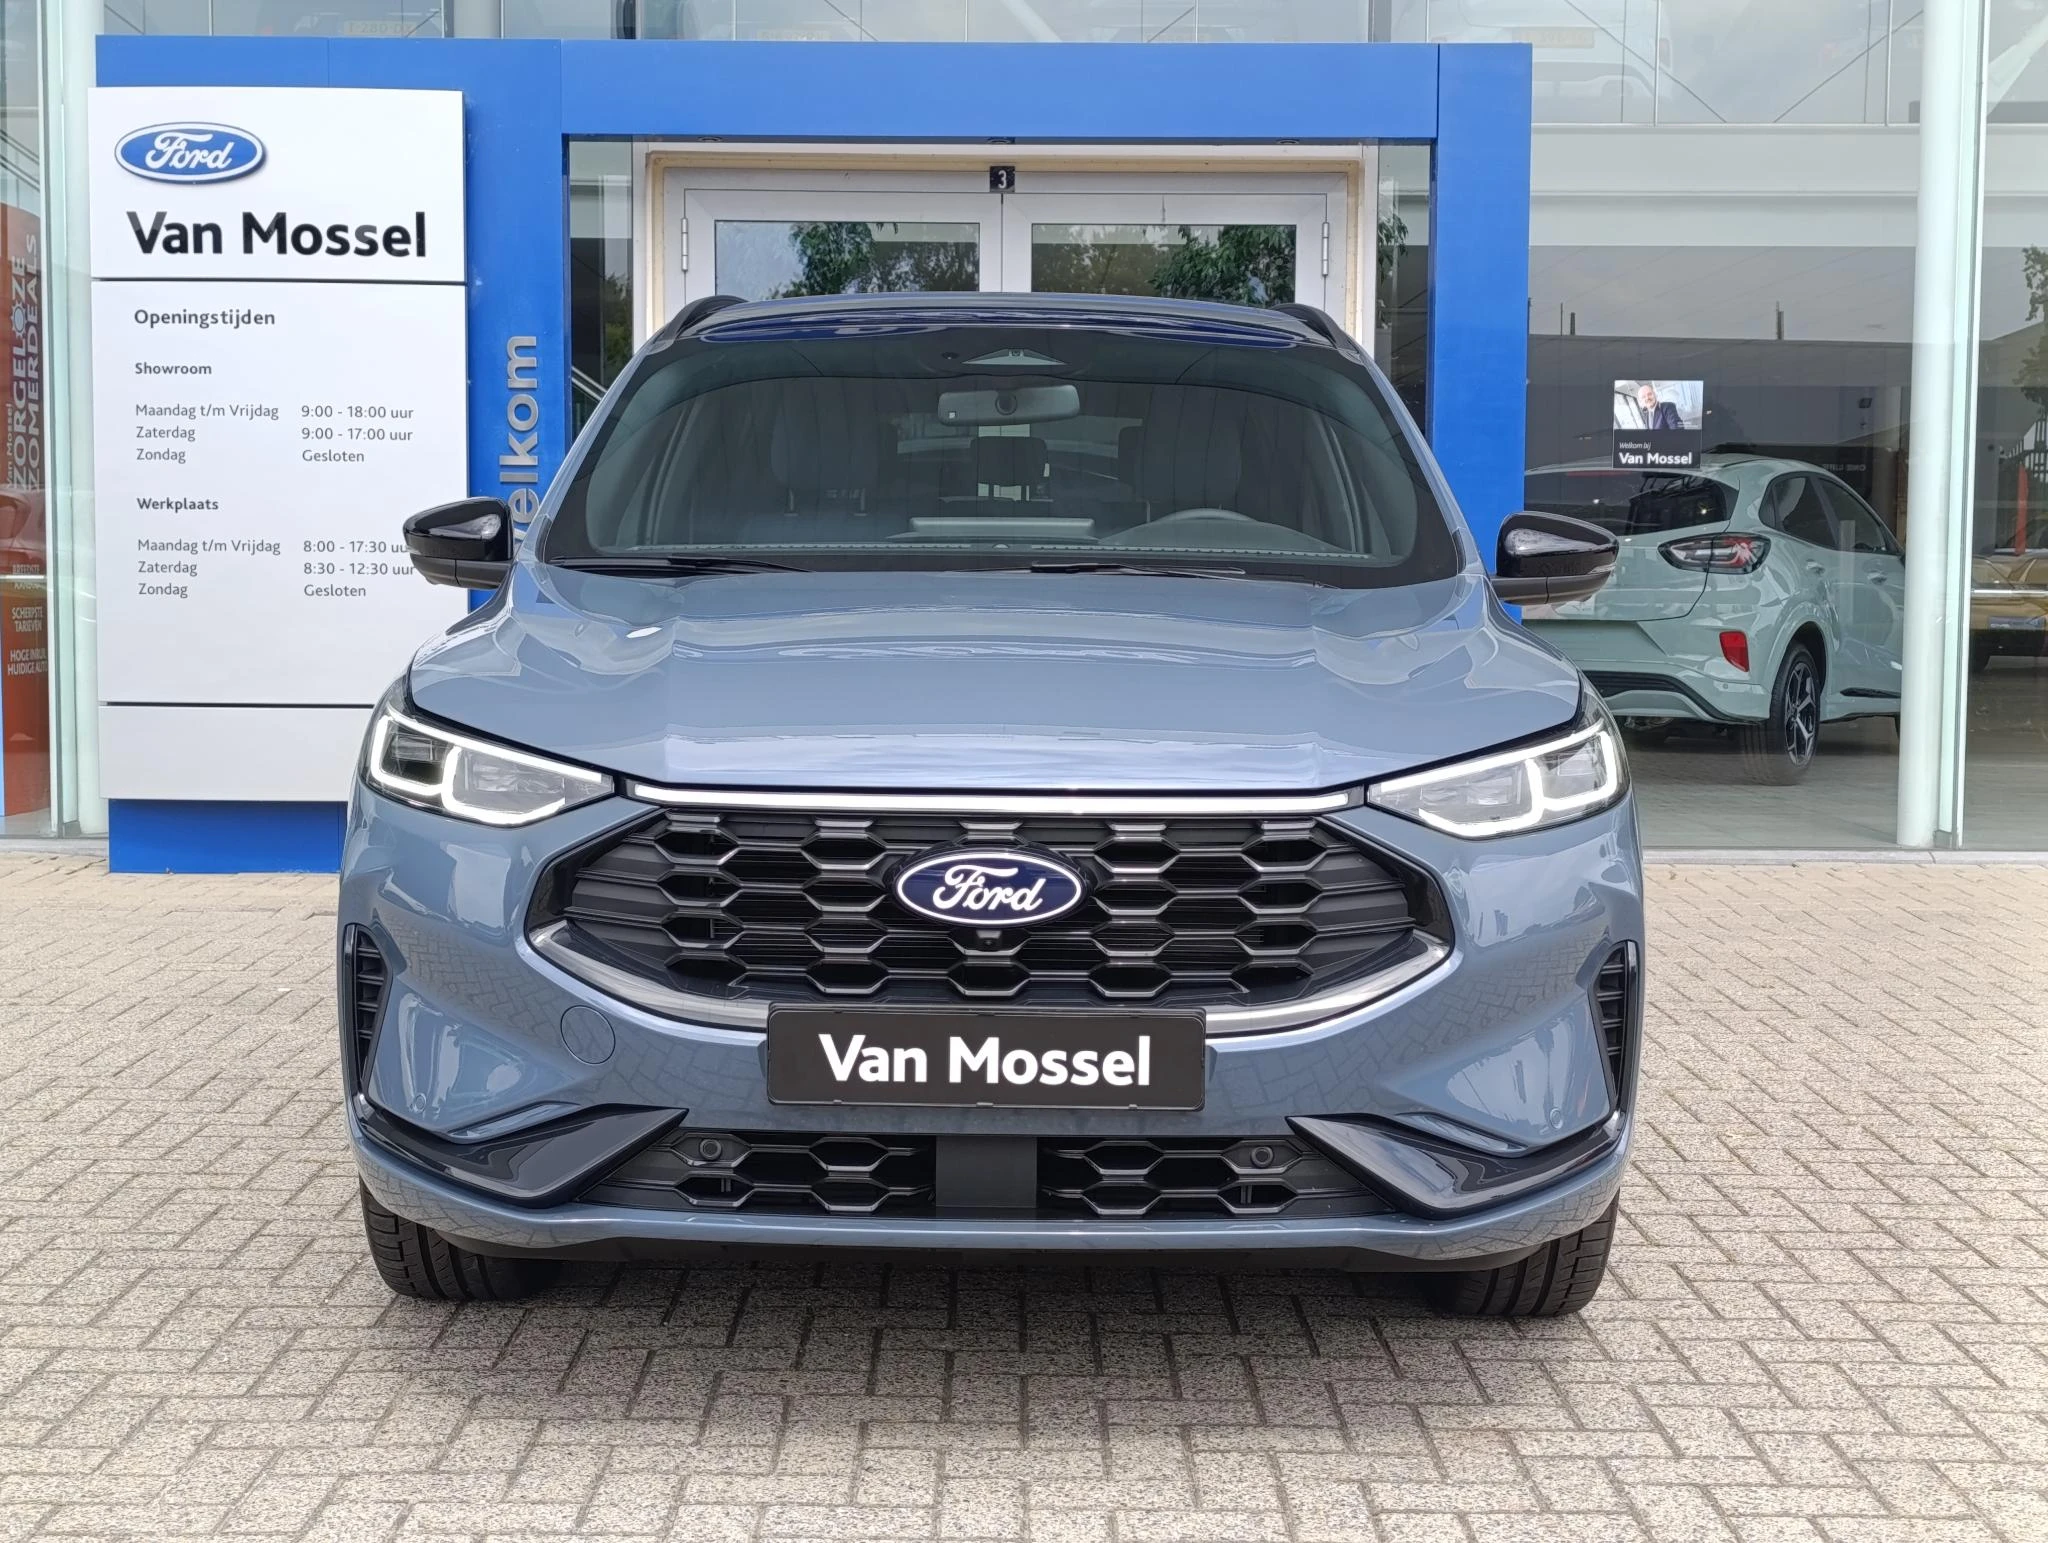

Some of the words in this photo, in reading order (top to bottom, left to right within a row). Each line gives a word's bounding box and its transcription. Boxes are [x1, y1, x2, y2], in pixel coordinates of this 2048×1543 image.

[145, 132, 234, 170] Ford
[998, 169, 1007, 189] 3
[127, 212, 222, 254] Van
[243, 212, 425, 257] Mossel
[134, 308, 275, 330] Openingstijden
[26, 234, 40, 490] ZOMERDEALS
[135, 361, 212, 375] Showroom
[135, 403, 197, 421] Maandag
[199, 403, 226, 417] t/m
[229, 403, 279, 421] Vrijdag
[301, 405, 333, 418] 9:00
[347, 405, 387, 419] 18:00
[390, 409, 414, 419] uur
[135, 425, 196, 443] Zaterdag
[301, 427, 334, 440] 9:00
[347, 427, 386, 441] 17:00
[389, 431, 414, 441] uur
[499, 335, 540, 541] elkom
[1619, 441, 1643, 449] Welkom
[136, 447, 187, 465] Zondag
[301, 449, 365, 462] Gesloten
[1619, 452, 1643, 465] Van
[1646, 452, 1692, 465] Mossel
[136, 496, 219, 514] Werkplaats
[137, 538, 199, 556] Maandag
[201, 538, 227, 552] t/m
[231, 539, 281, 556] Vrijdag
[303, 540, 335, 553] 8:00
[349, 540, 387, 553] 17:30
[391, 544, 407, 553] uu
[137, 560, 198, 578] Zaterdag
[303, 562, 336, 575] 8:30
[349, 562, 389, 576] 12:30
[138, 582, 189, 599] Zondag
[303, 583, 367, 597] Gesloten
[10, 648, 29, 661] HOGE
[8, 662, 35, 675] HUIDIGE
[932, 865, 1047, 912] Ford
[819, 1034, 927, 1082] Van
[949, 1036, 1150, 1086] Mossel
